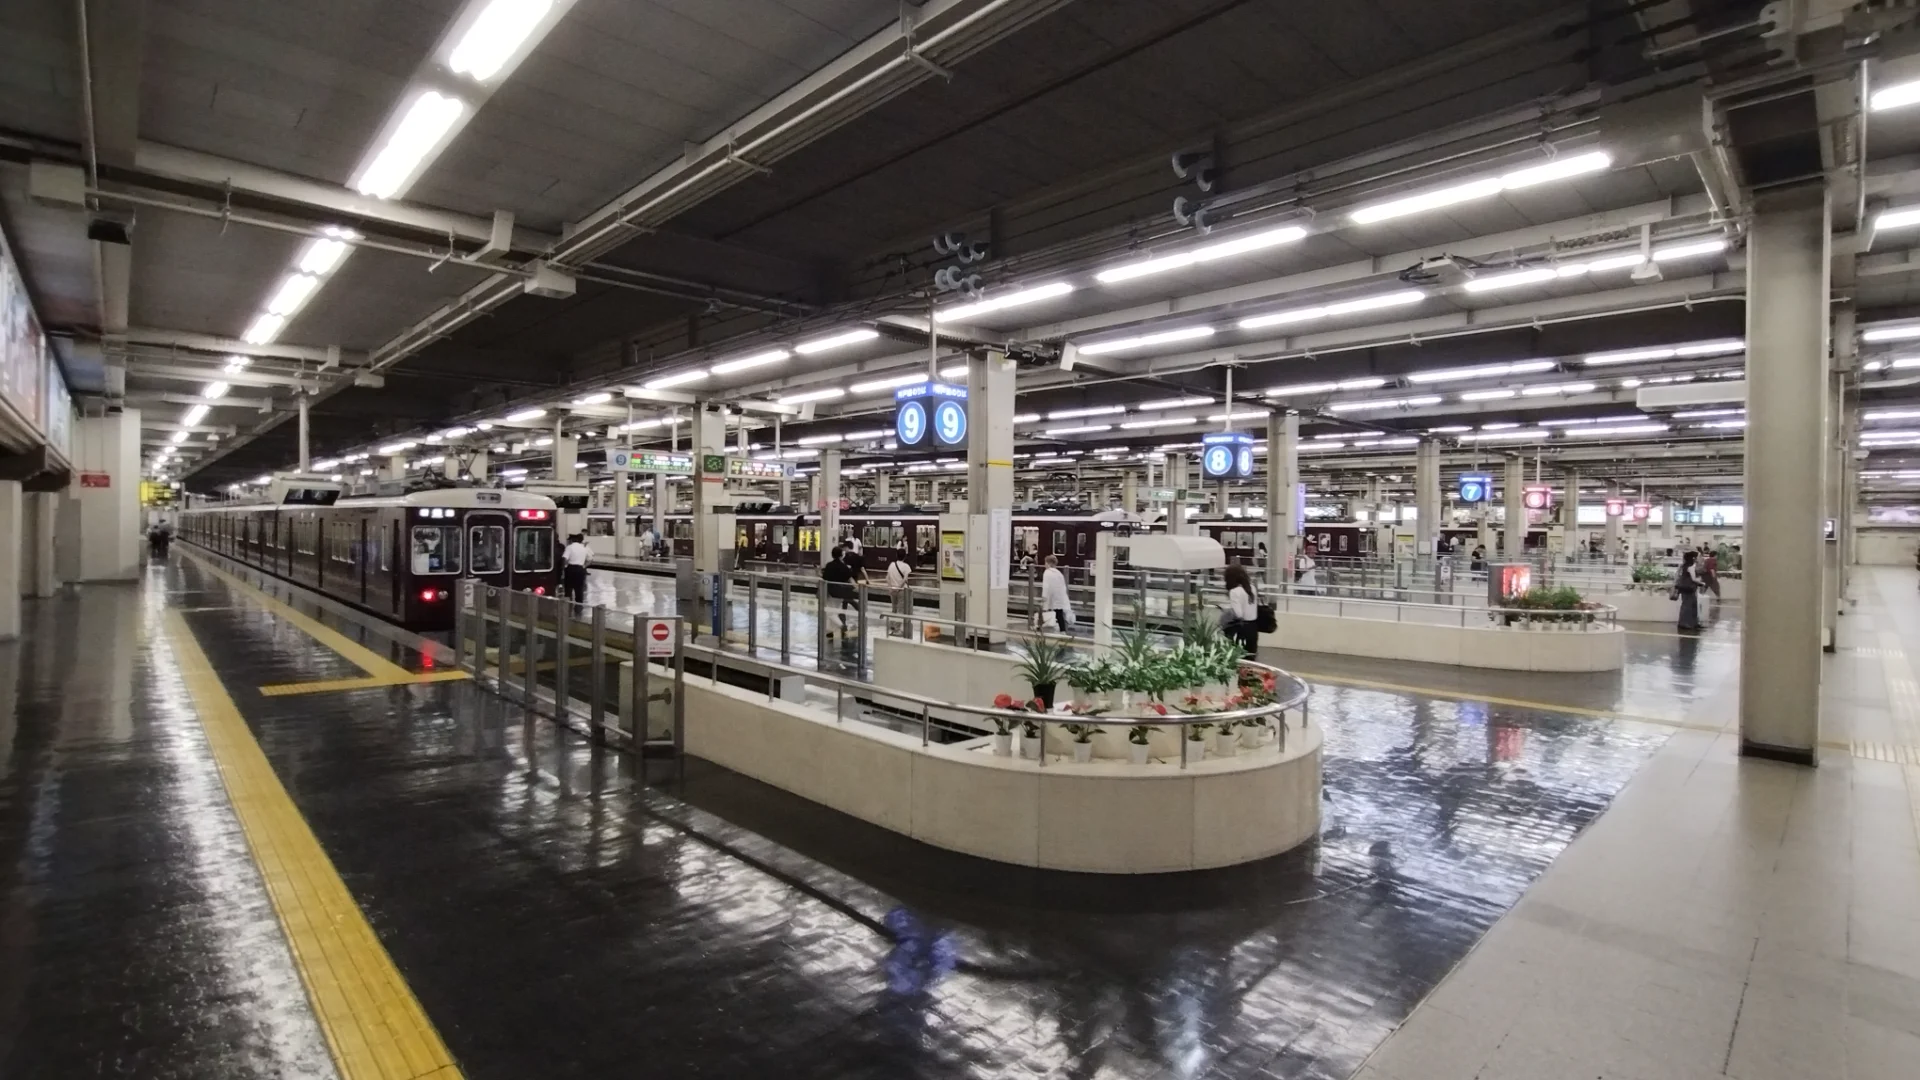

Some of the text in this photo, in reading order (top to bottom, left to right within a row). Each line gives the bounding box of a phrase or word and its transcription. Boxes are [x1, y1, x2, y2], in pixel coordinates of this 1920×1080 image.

[904, 407, 919, 439] 9
[942, 406, 959, 438] 9
[1211, 449, 1226, 471] 8
[1466, 485, 1478, 499] 7
